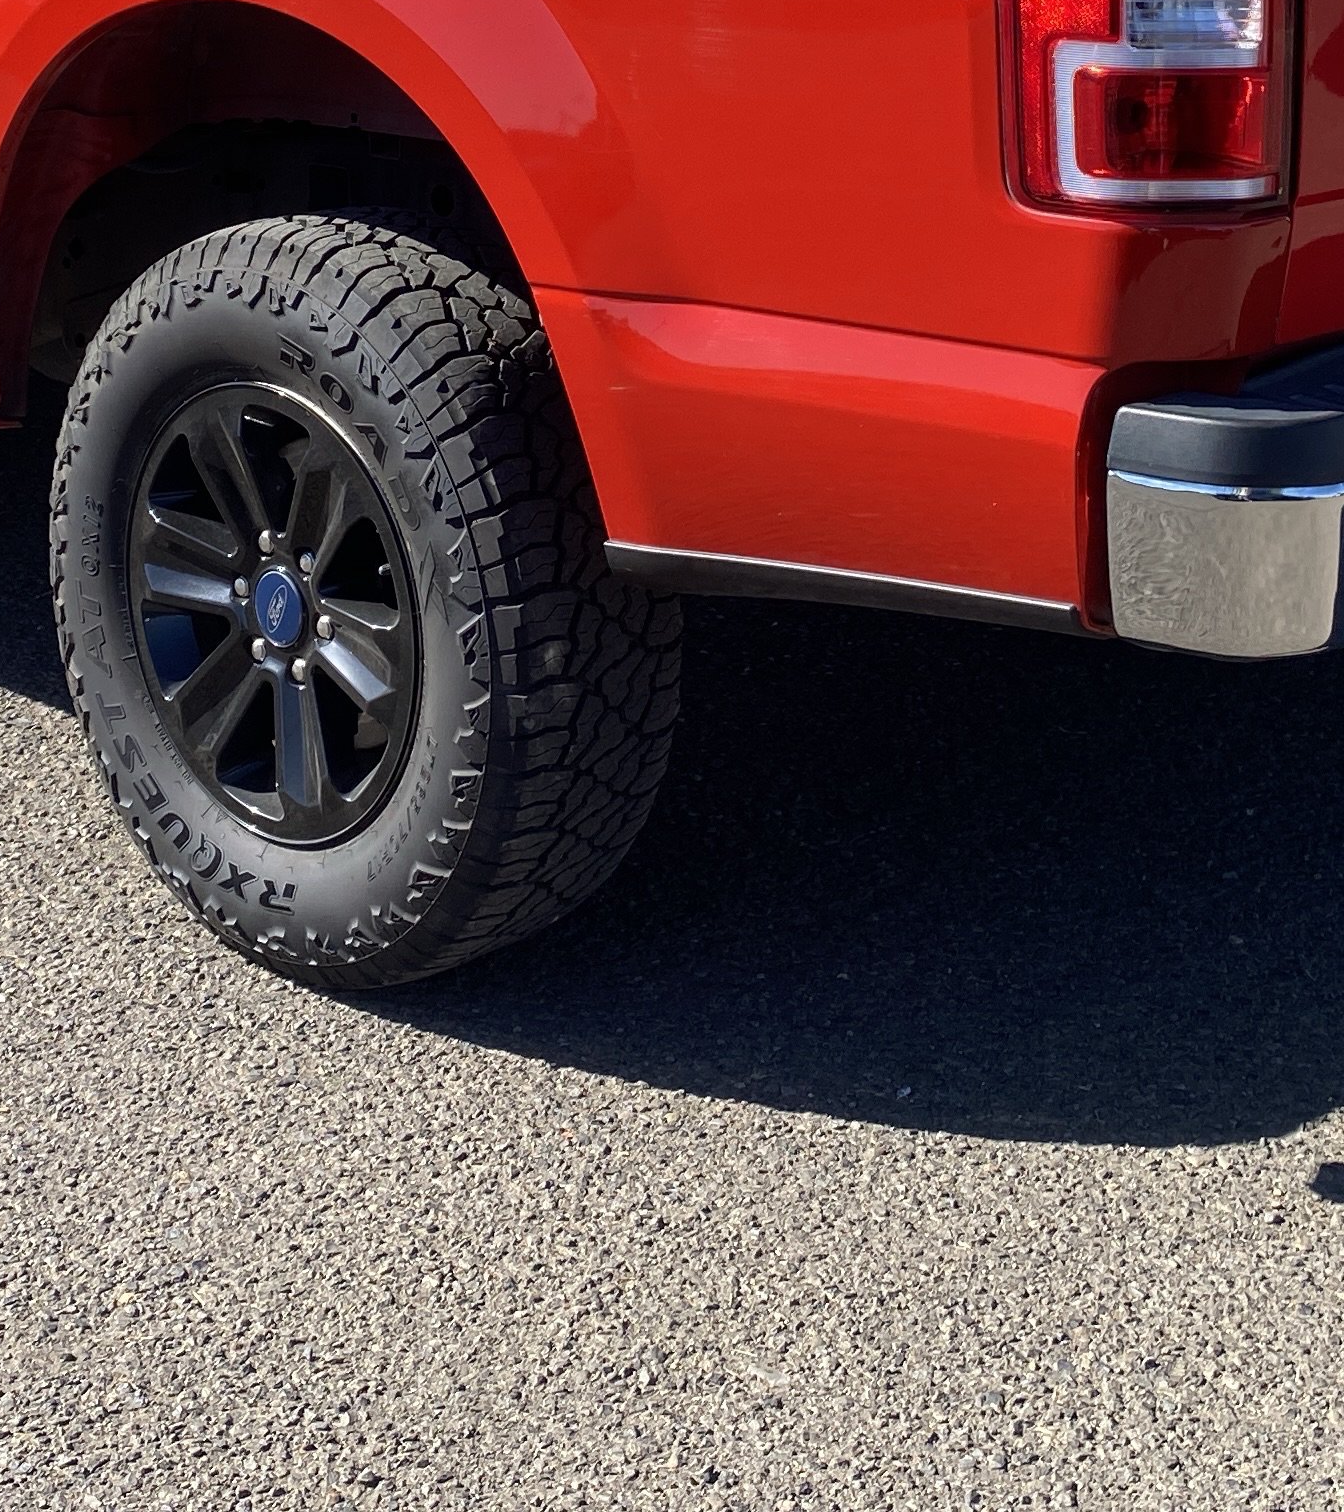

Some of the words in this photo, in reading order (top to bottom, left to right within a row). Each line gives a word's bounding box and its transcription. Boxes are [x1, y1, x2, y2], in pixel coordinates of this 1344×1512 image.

[83, 494, 106, 578] QX12
[74, 578, 113, 679] AT
[95, 692, 298, 916] RXQUEST
